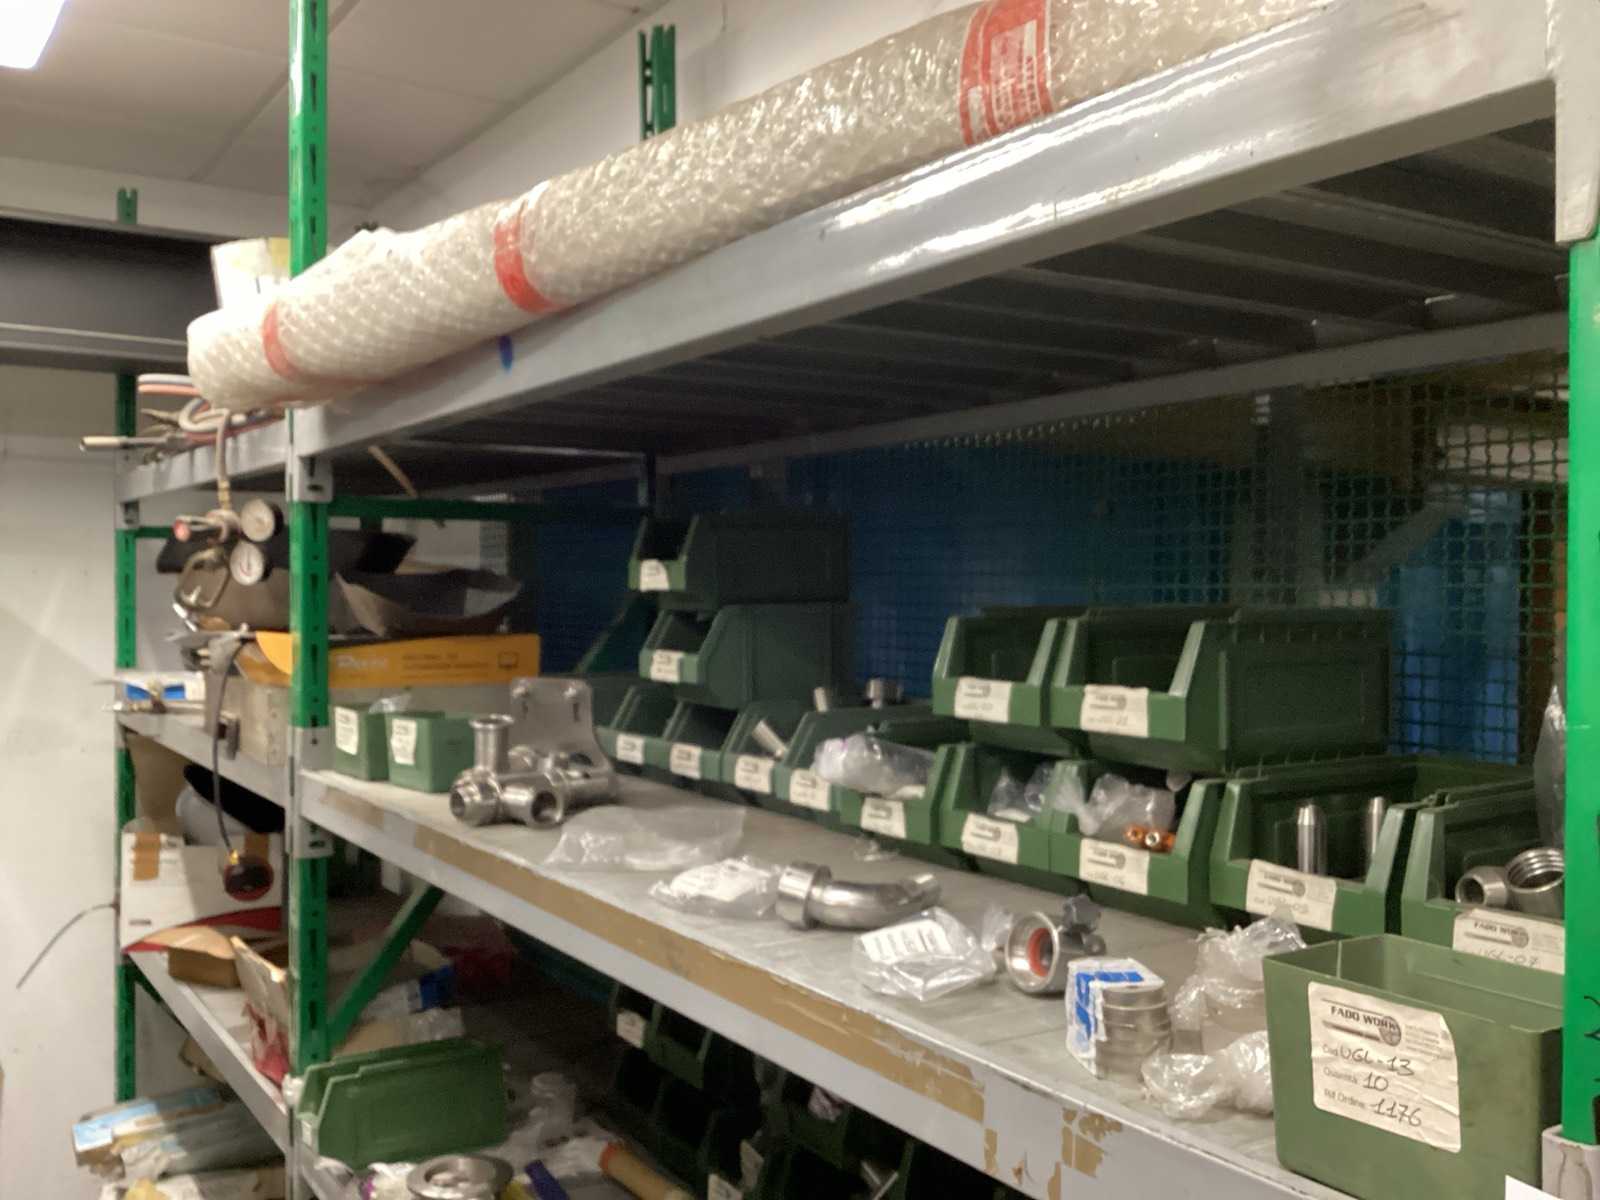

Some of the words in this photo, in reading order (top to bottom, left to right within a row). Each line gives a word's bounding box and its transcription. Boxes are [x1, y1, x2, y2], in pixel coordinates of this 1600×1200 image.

[1331, 1005, 1360, 1022] FADO
[1363, 1072, 1389, 1092] 10
[1370, 1098, 1422, 1127] 1176
